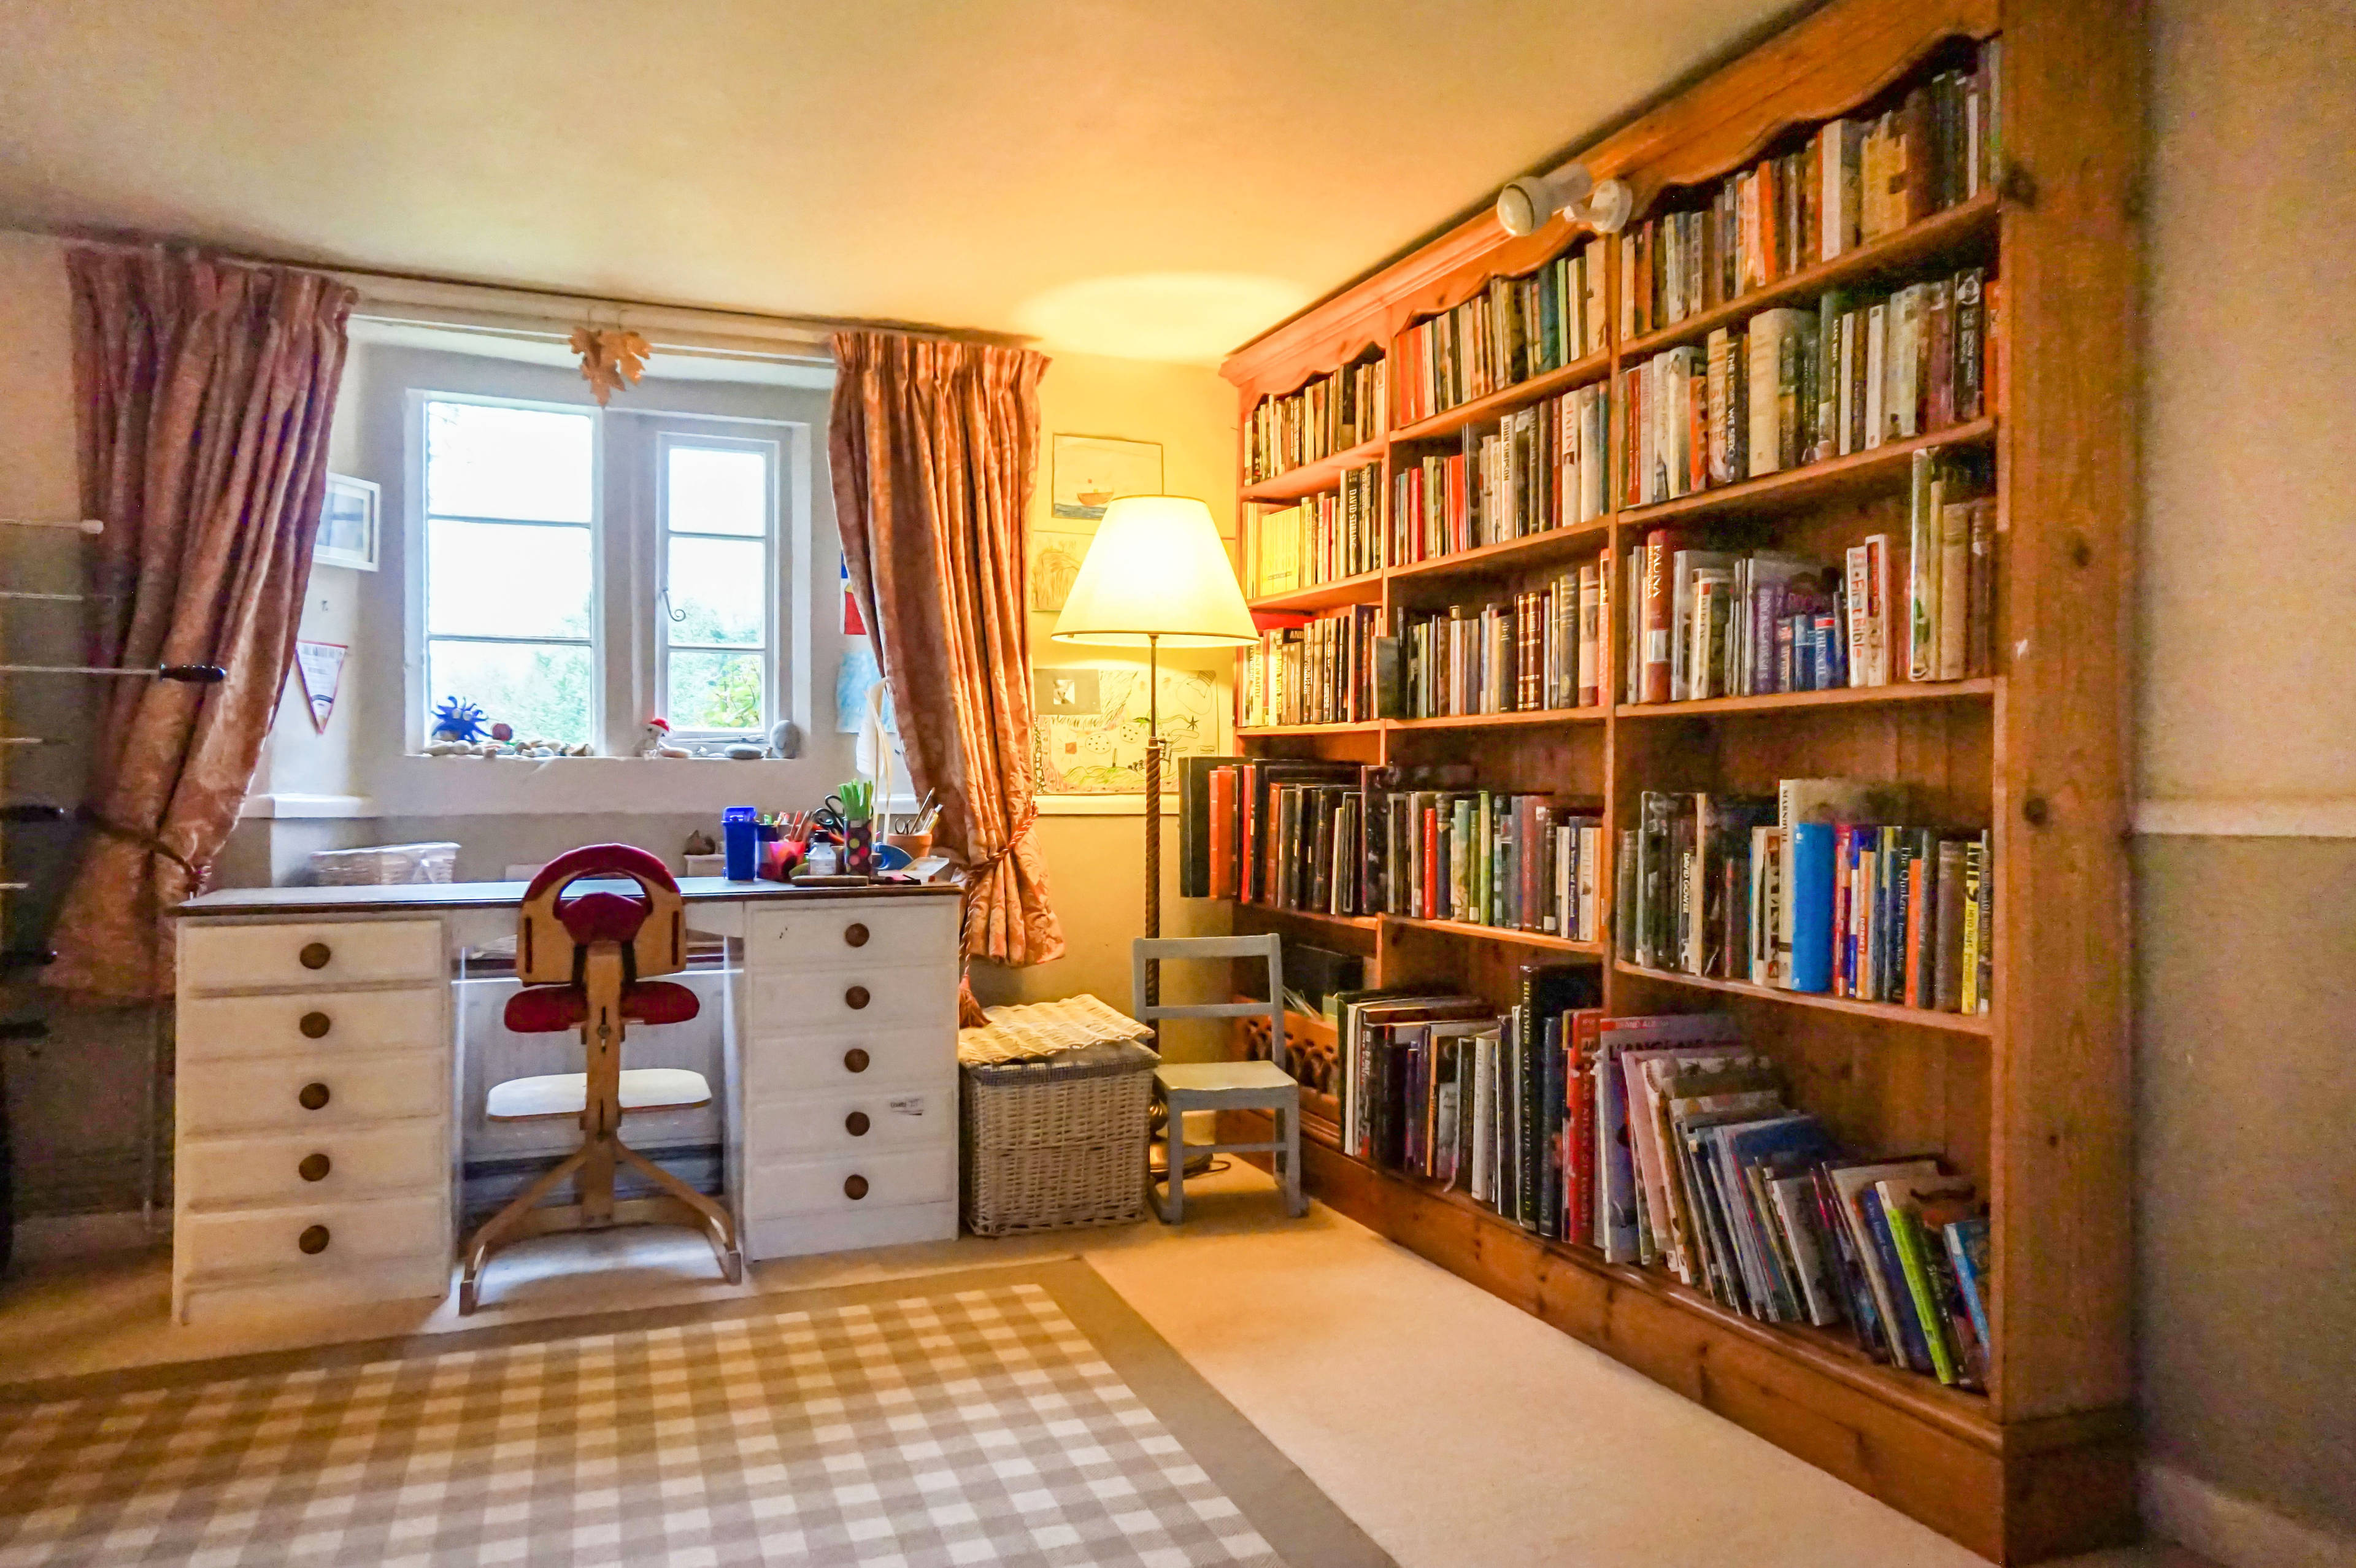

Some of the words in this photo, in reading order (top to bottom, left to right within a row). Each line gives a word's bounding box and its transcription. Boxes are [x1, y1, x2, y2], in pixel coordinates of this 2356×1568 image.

[1727, 407, 1735, 426] WE
[1349, 489, 1358, 513] DAVID
[1653, 545, 1663, 598] FAUNA
[1852, 618, 1866, 658] Bible
[1900, 847, 1912, 864] The
